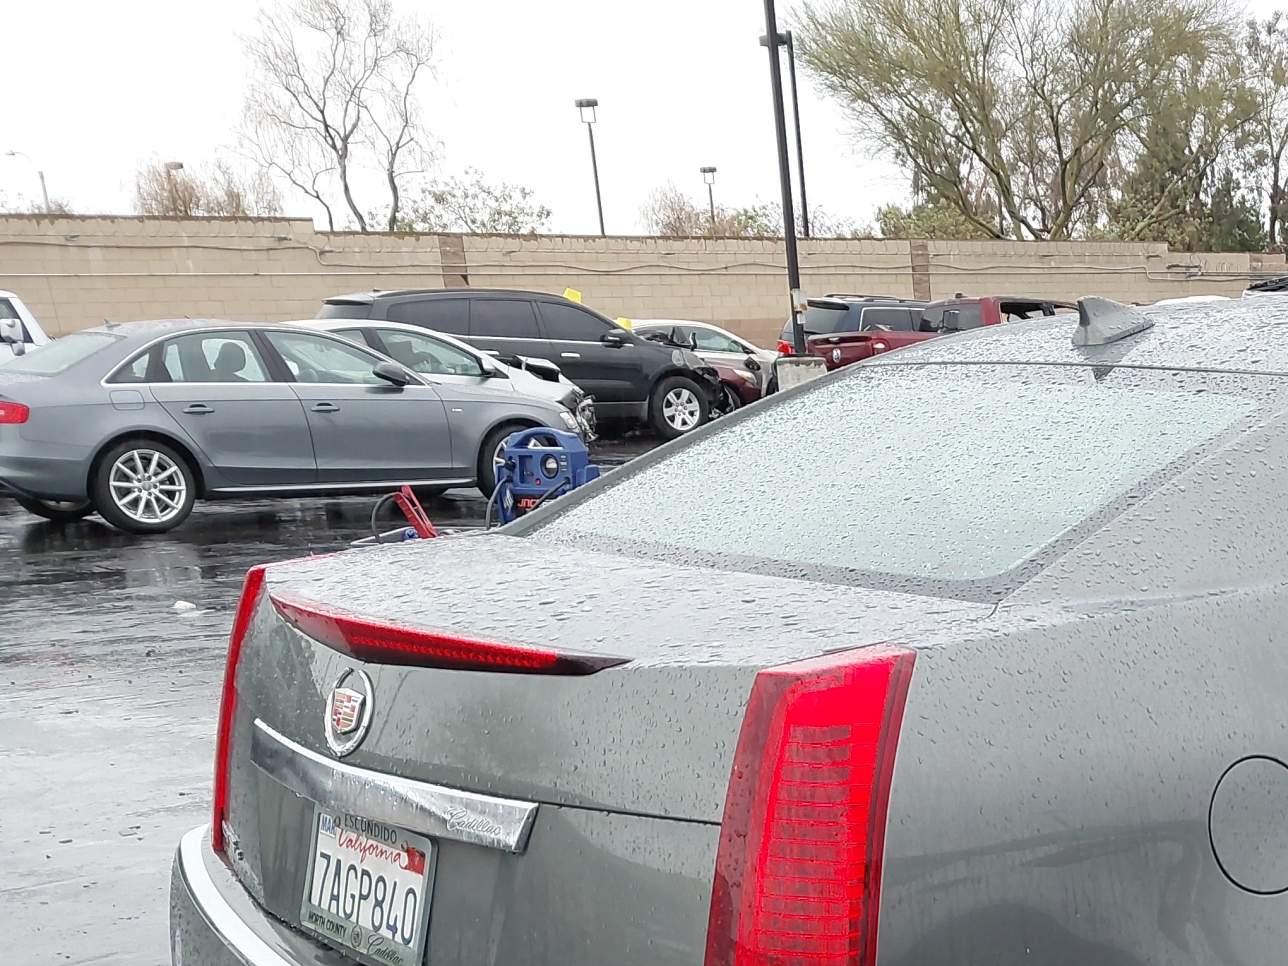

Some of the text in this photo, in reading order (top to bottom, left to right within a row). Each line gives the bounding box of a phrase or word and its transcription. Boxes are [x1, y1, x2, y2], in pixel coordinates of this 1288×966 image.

[344, 813, 398, 843] ESCONDIDO
[446, 807, 503, 837] Cadillac
[318, 852, 417, 946] 7AGP840
[325, 918, 347, 938] COUNTY
[367, 932, 405, 965] Cadillac
